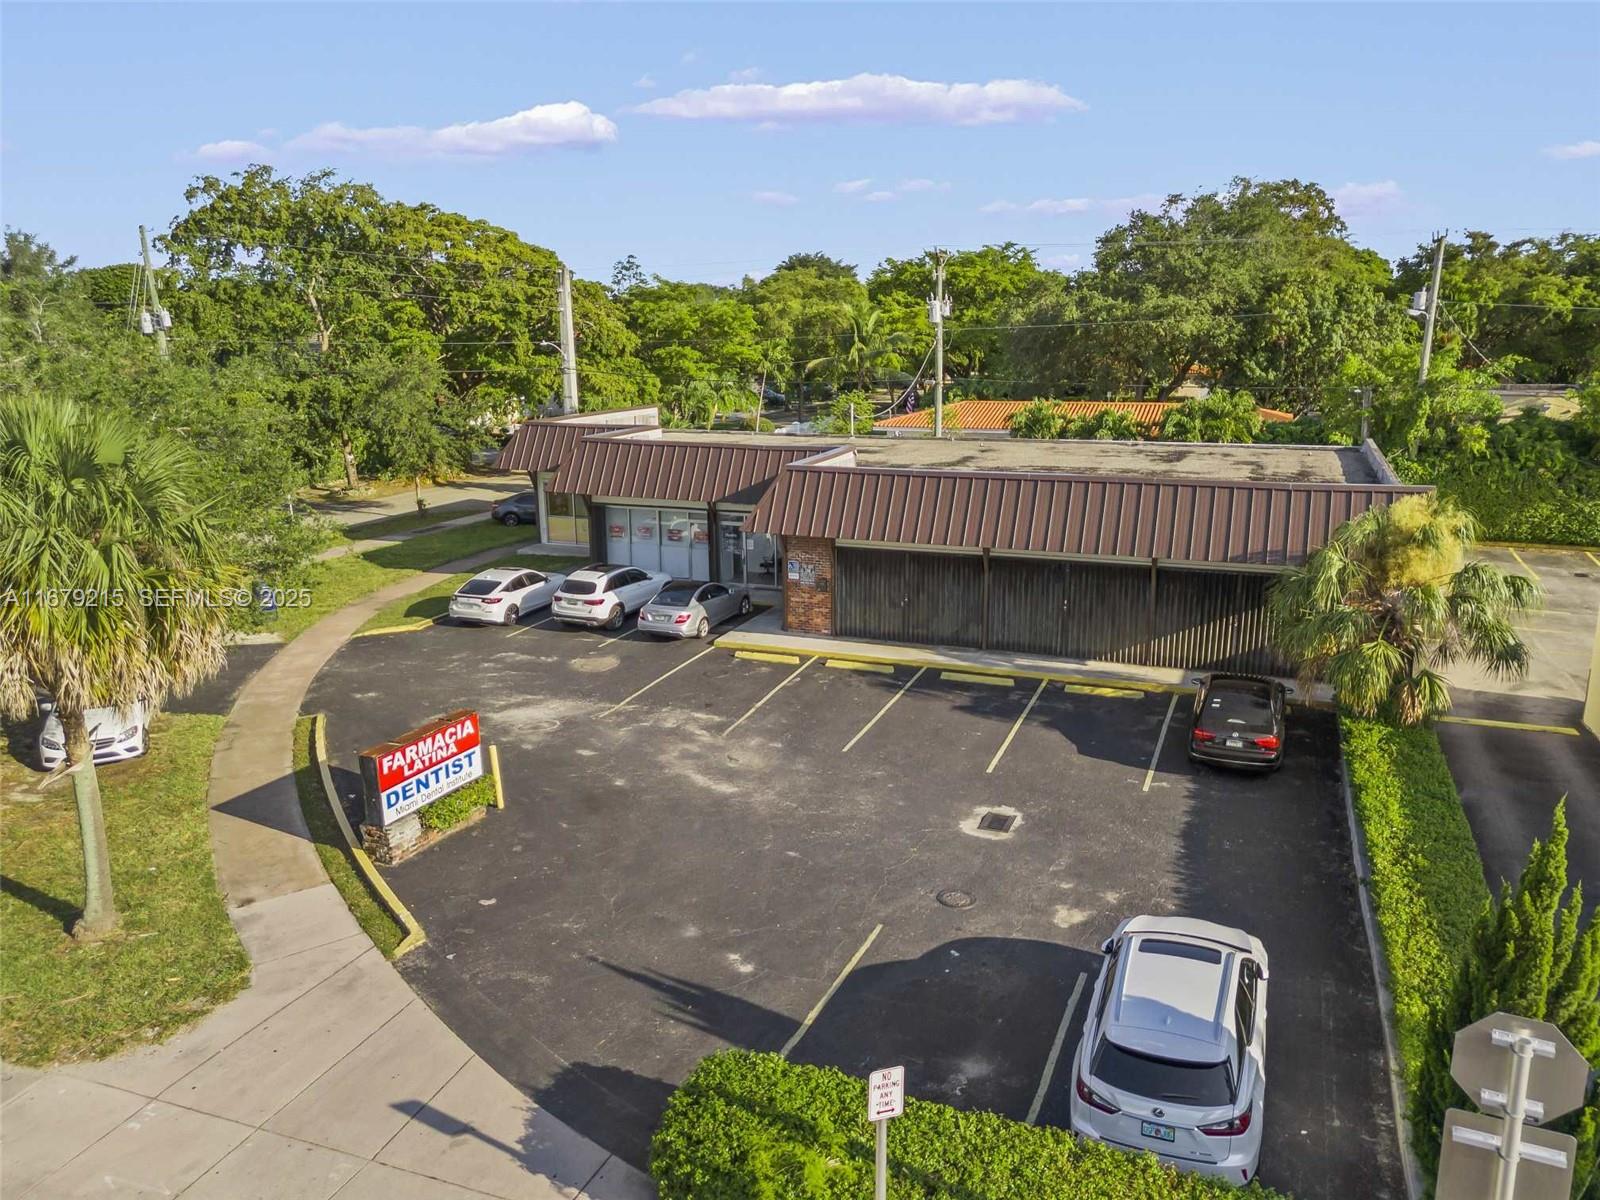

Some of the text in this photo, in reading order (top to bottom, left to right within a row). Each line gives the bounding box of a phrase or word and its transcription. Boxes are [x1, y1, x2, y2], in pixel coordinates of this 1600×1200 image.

[382, 719, 475, 775] FARMACIA
[403, 743, 458, 777] LATINA
[386, 751, 476, 810] DENTIST
[395, 770, 473, 817] Miami Dental Institute
[873, 1080, 900, 1090] PARKING
[882, 1072, 892, 1081] NO
[879, 1091, 893, 1099] ANY
